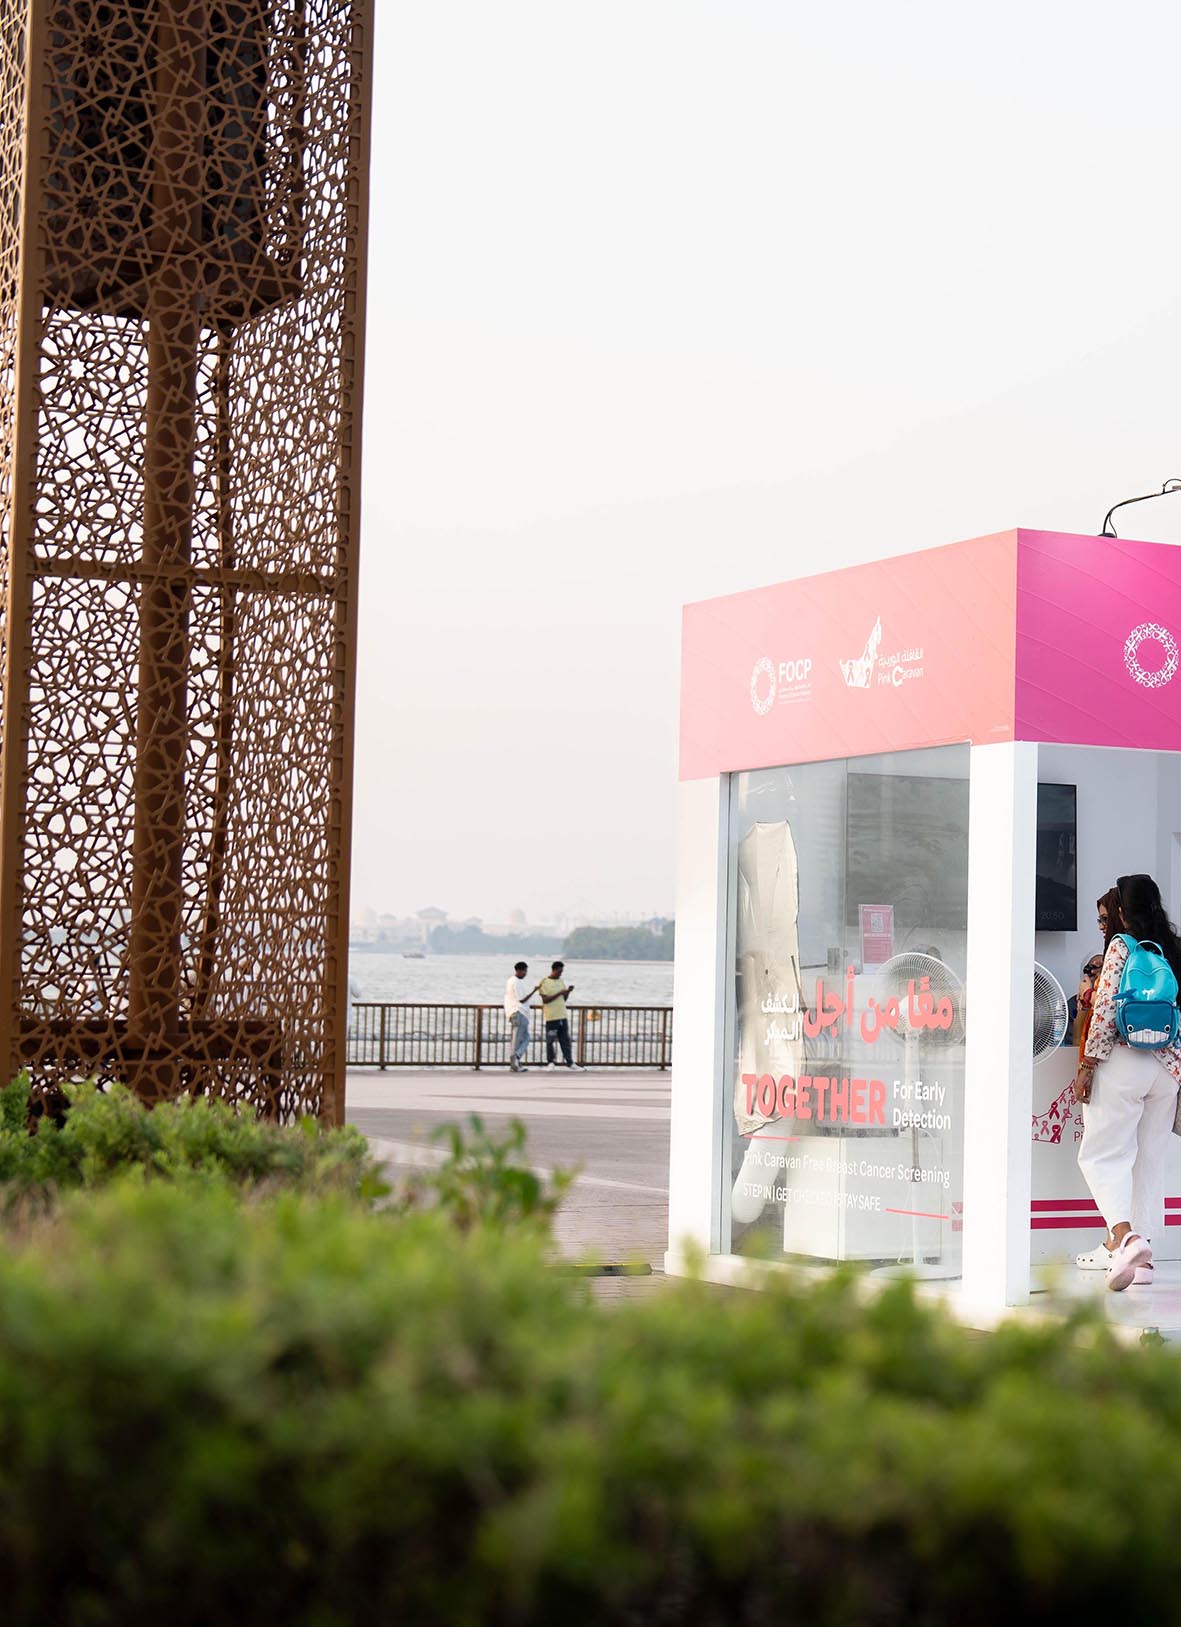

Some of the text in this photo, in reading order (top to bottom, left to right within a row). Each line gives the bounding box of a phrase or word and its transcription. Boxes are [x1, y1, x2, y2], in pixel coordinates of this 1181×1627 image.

[778, 658, 812, 683] FOCP
[761, 992, 799, 1014] الكشف
[803, 965, 855, 1038] أجل
[860, 997, 901, 1044] من
[741, 1073, 887, 1125] TOGETHER
[893, 1080, 946, 1106] For Early
[892, 1108, 951, 1130] Detection
[744, 1150, 763, 1166] Pink
[764, 1151, 801, 1169] Caravan
[859, 1160, 896, 1179] Cancer
[897, 1163, 950, 1189] Screening
[743, 1182, 763, 1198] STEP
[763, 1184, 772, 1200] IN
[776, 1186, 792, 1202] GET
[858, 1194, 881, 1212] SAFE
